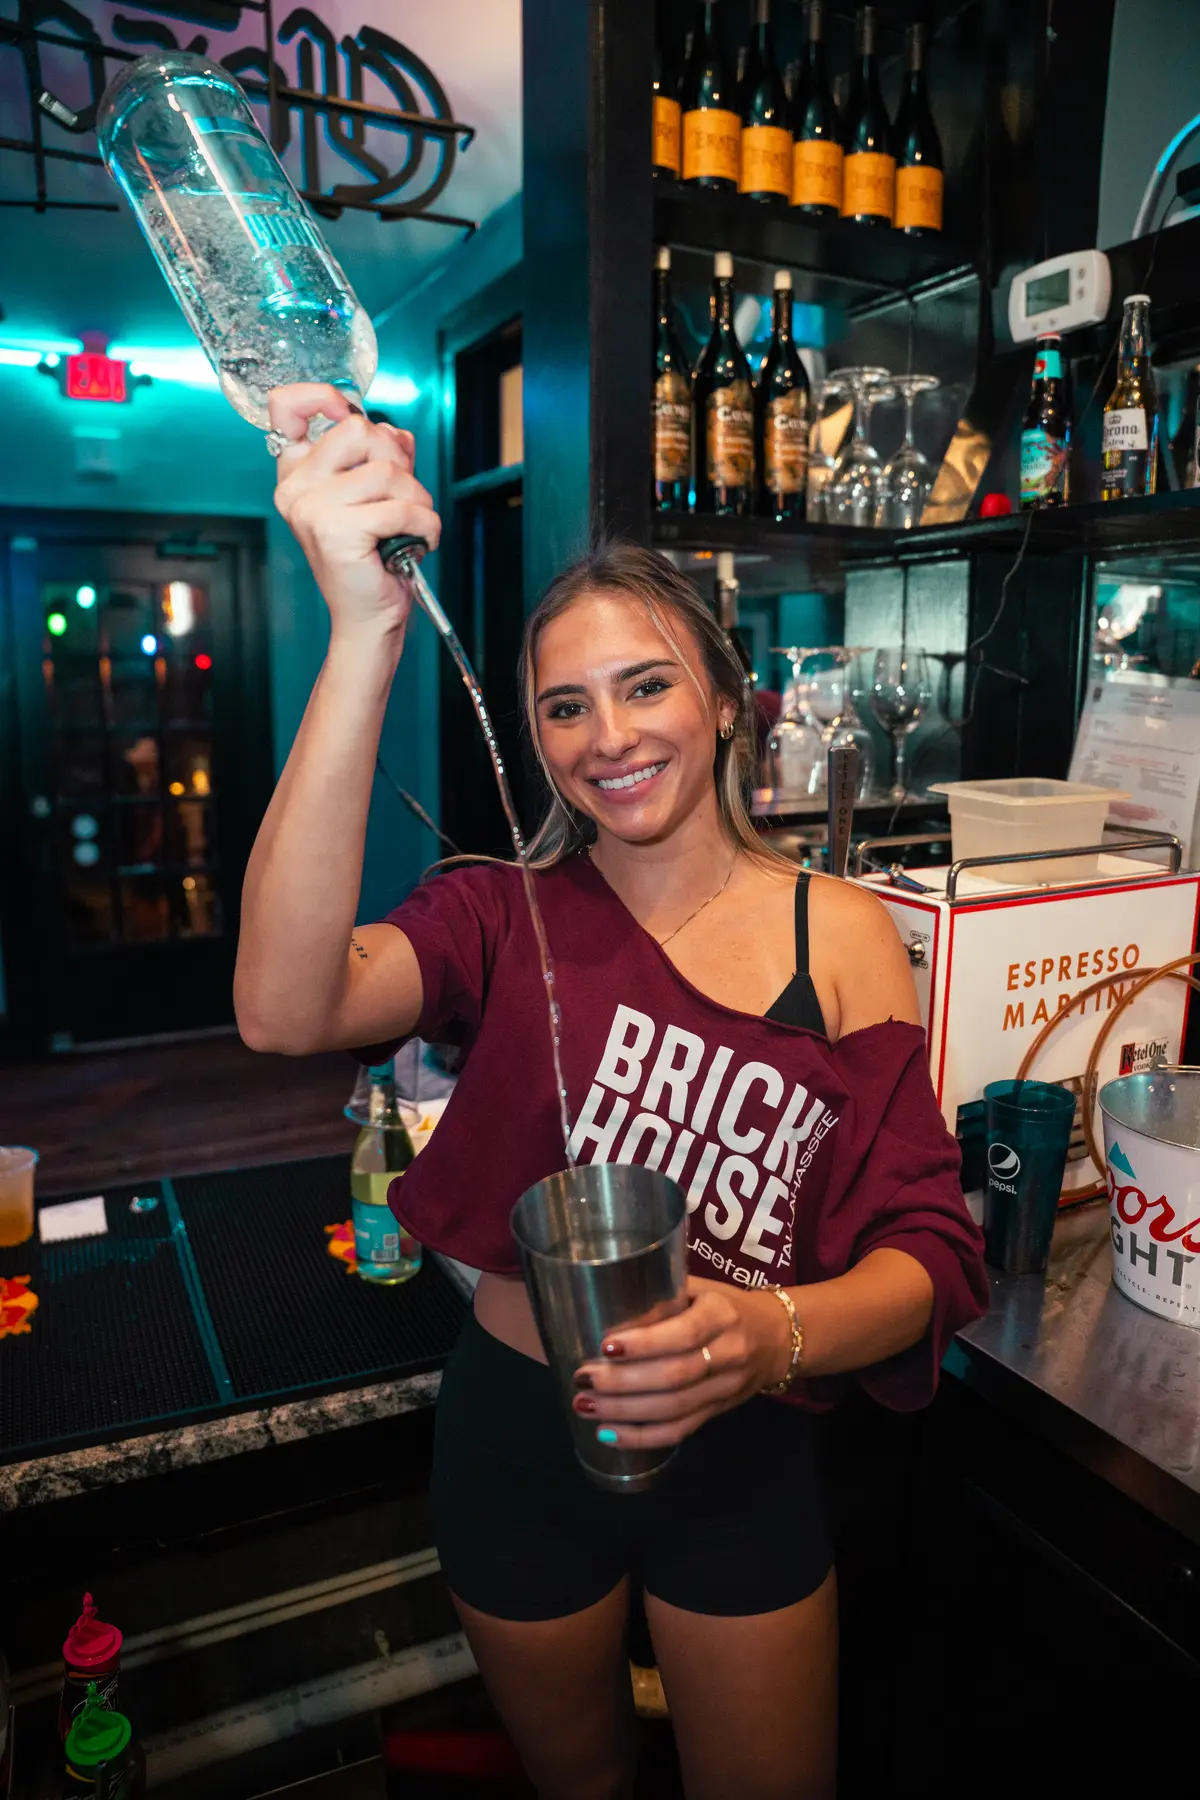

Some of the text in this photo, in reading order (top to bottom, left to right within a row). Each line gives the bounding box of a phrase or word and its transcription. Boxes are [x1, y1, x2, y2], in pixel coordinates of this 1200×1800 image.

[1103, 425, 1138, 438] orona
[839, 752, 850, 834] KETEL ONE
[1007, 943, 1140, 991] ESPRESSO
[1133, 1062, 1152, 1072] VODK
[1149, 1041, 1167, 1058] One
[594, 1003, 826, 1183] BRICK
[565, 1083, 791, 1264] HOUSE
[776, 1109, 840, 1268] TALLAHASSEE
[1110, 1215, 1196, 1287] GHT
